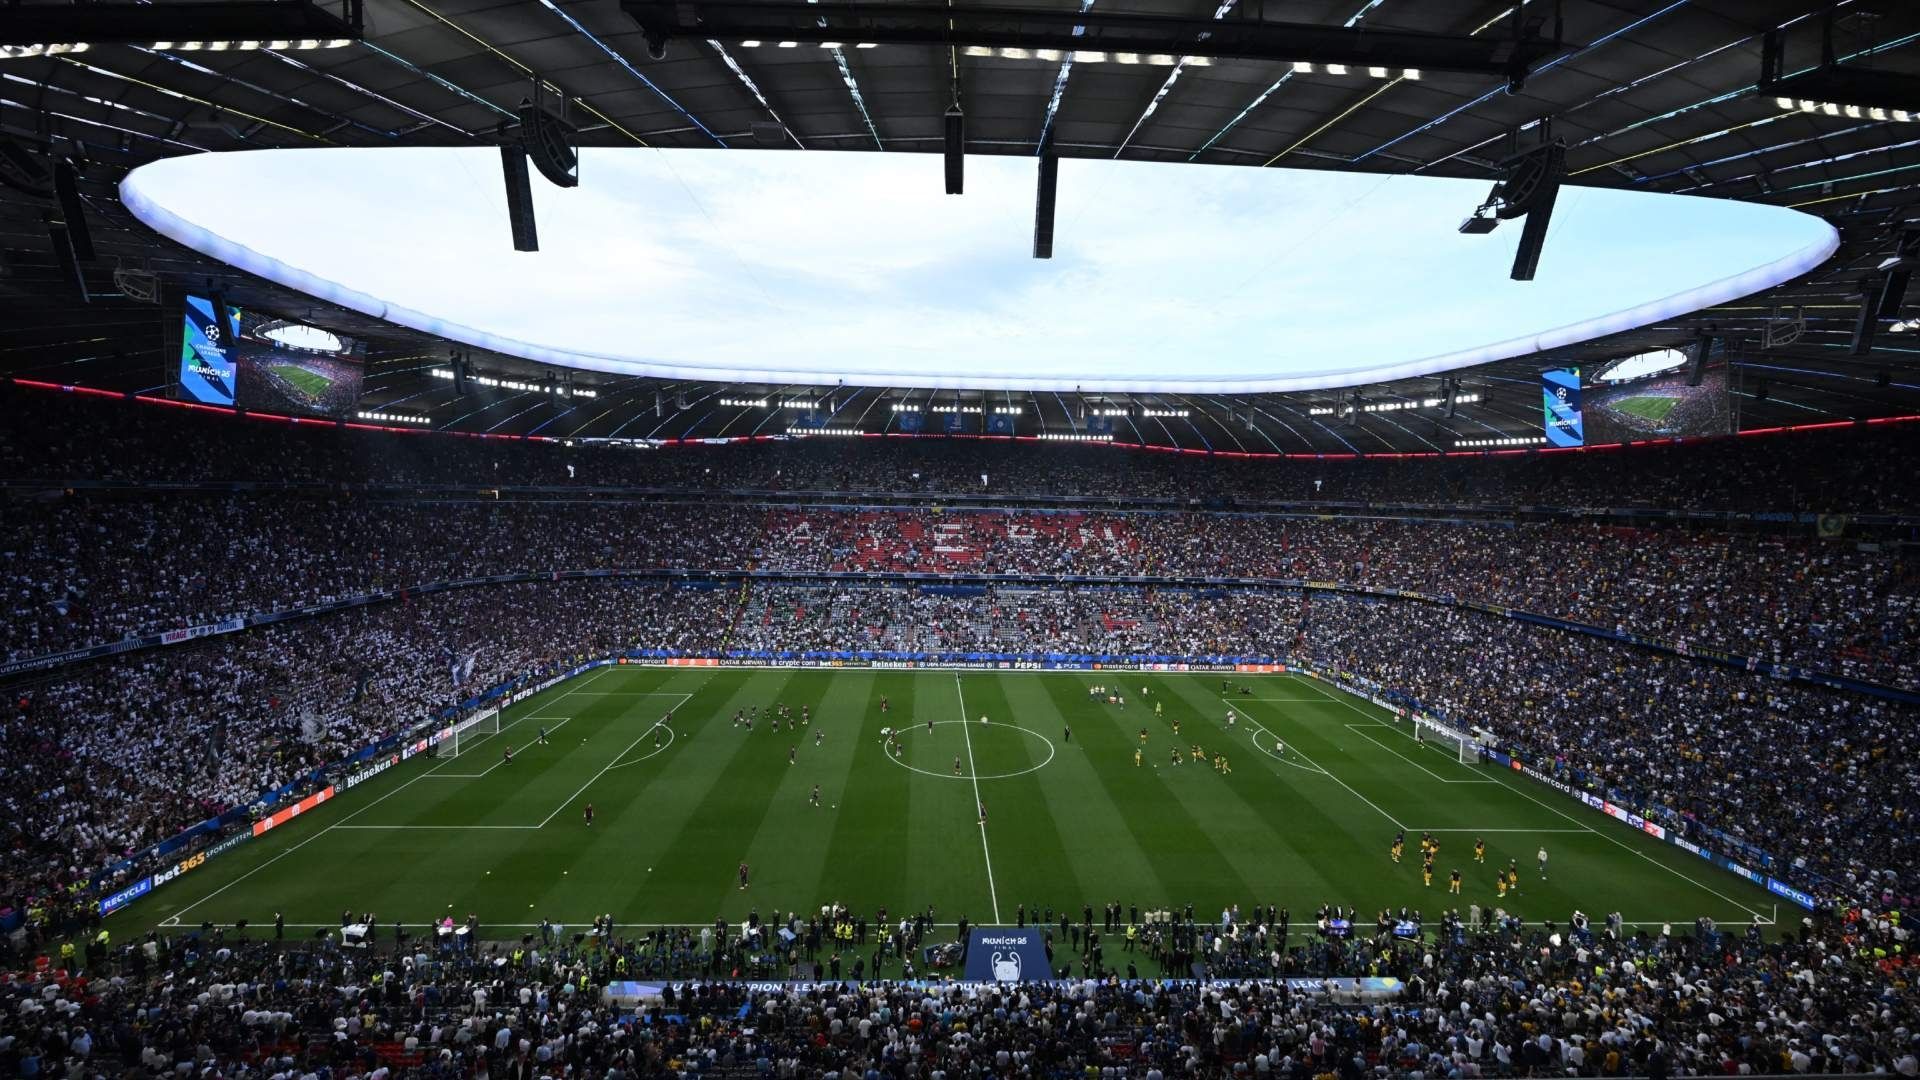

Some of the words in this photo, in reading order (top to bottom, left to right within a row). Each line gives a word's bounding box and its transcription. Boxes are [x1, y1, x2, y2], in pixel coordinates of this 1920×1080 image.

[165, 630, 187, 642] VIRAGE
[513, 687, 534, 703] PEPSI
[347, 759, 391, 788] Heineken
[1522, 765, 1570, 793] mastercard
[1588, 796, 1617, 817] FedEx
[1627, 813, 1659, 837] FedEx
[154, 851, 206, 887] bet365
[206, 830, 252, 858] SPORTWETTEN
[104, 882, 147, 909] RECYCLE
[1773, 881, 1815, 908] RECYCLE
